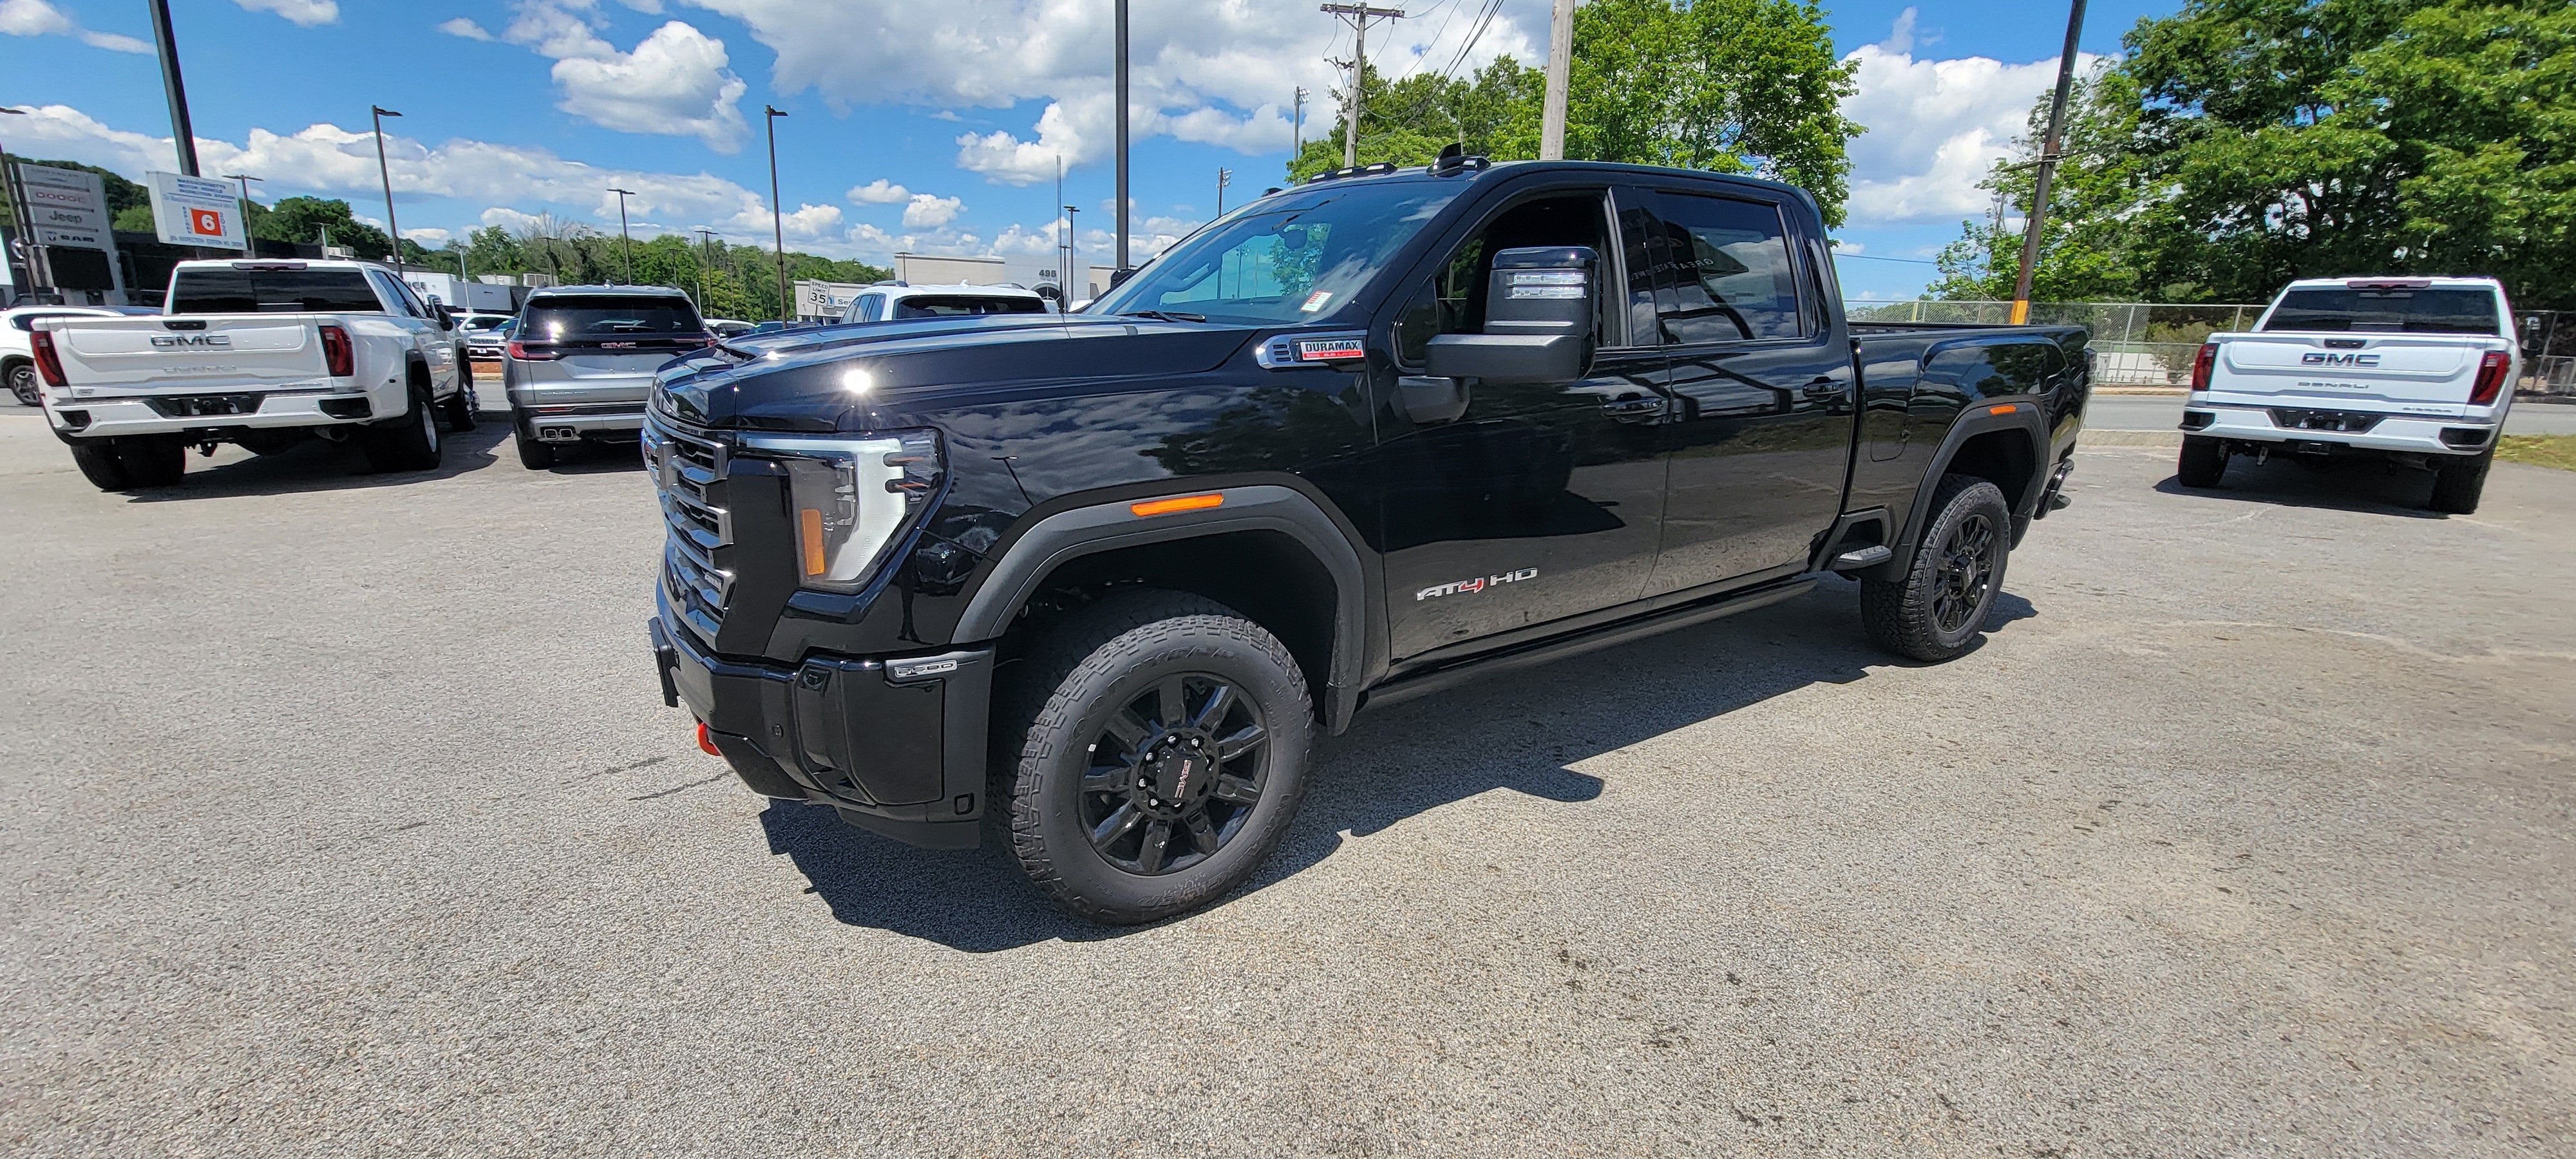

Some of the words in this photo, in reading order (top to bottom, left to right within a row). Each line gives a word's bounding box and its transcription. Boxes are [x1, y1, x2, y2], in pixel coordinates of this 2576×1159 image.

[36, 193, 86, 203] DODGE
[48, 211, 82, 223] Jeep
[201, 214, 216, 231] 6
[1039, 269, 1057, 278] 495
[810, 292, 826, 303] 35
[150, 335, 231, 346] GMC
[1305, 341, 1359, 352] DURAMAX
[2302, 353, 2382, 366] GMC
[1417, 578, 1484, 601] AT4
[1490, 568, 1538, 586] HD
[1175, 759, 1192, 798] GMC
